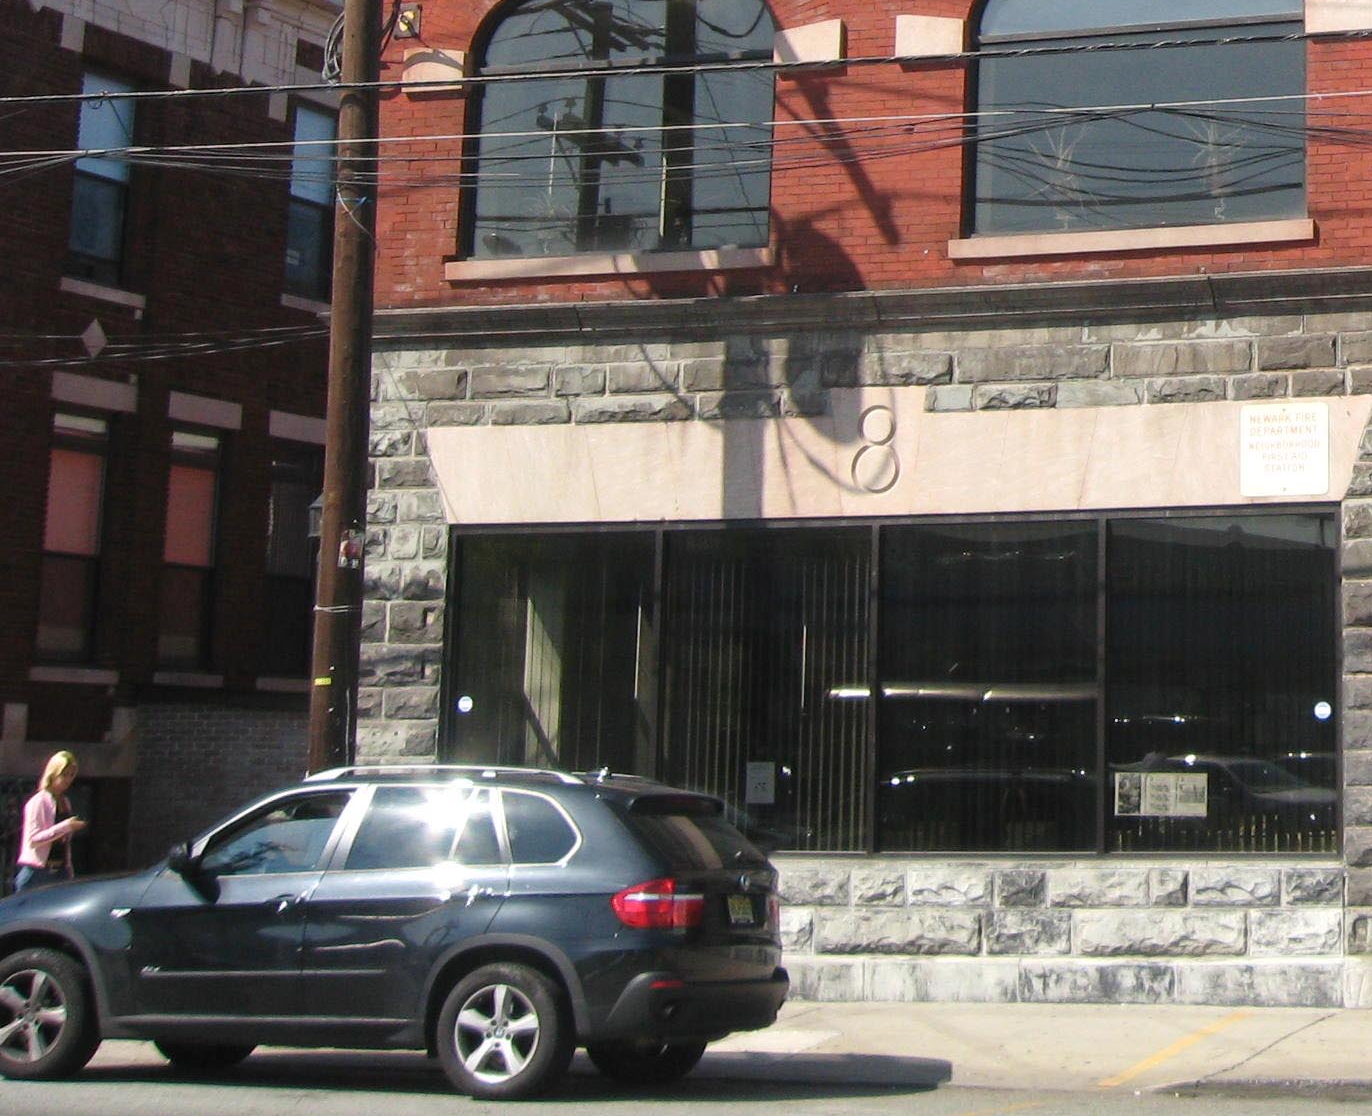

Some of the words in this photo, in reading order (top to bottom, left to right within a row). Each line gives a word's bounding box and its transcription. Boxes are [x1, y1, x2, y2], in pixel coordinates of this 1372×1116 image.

[1249, 413, 1292, 424] NEWARK
[1295, 412, 1317, 422] FIRE
[1249, 425, 1318, 437] DEPARTMENT
[1262, 452, 1288, 462] FIRST
[1291, 452, 1309, 461] AID
[1263, 463, 1305, 473] STATION
